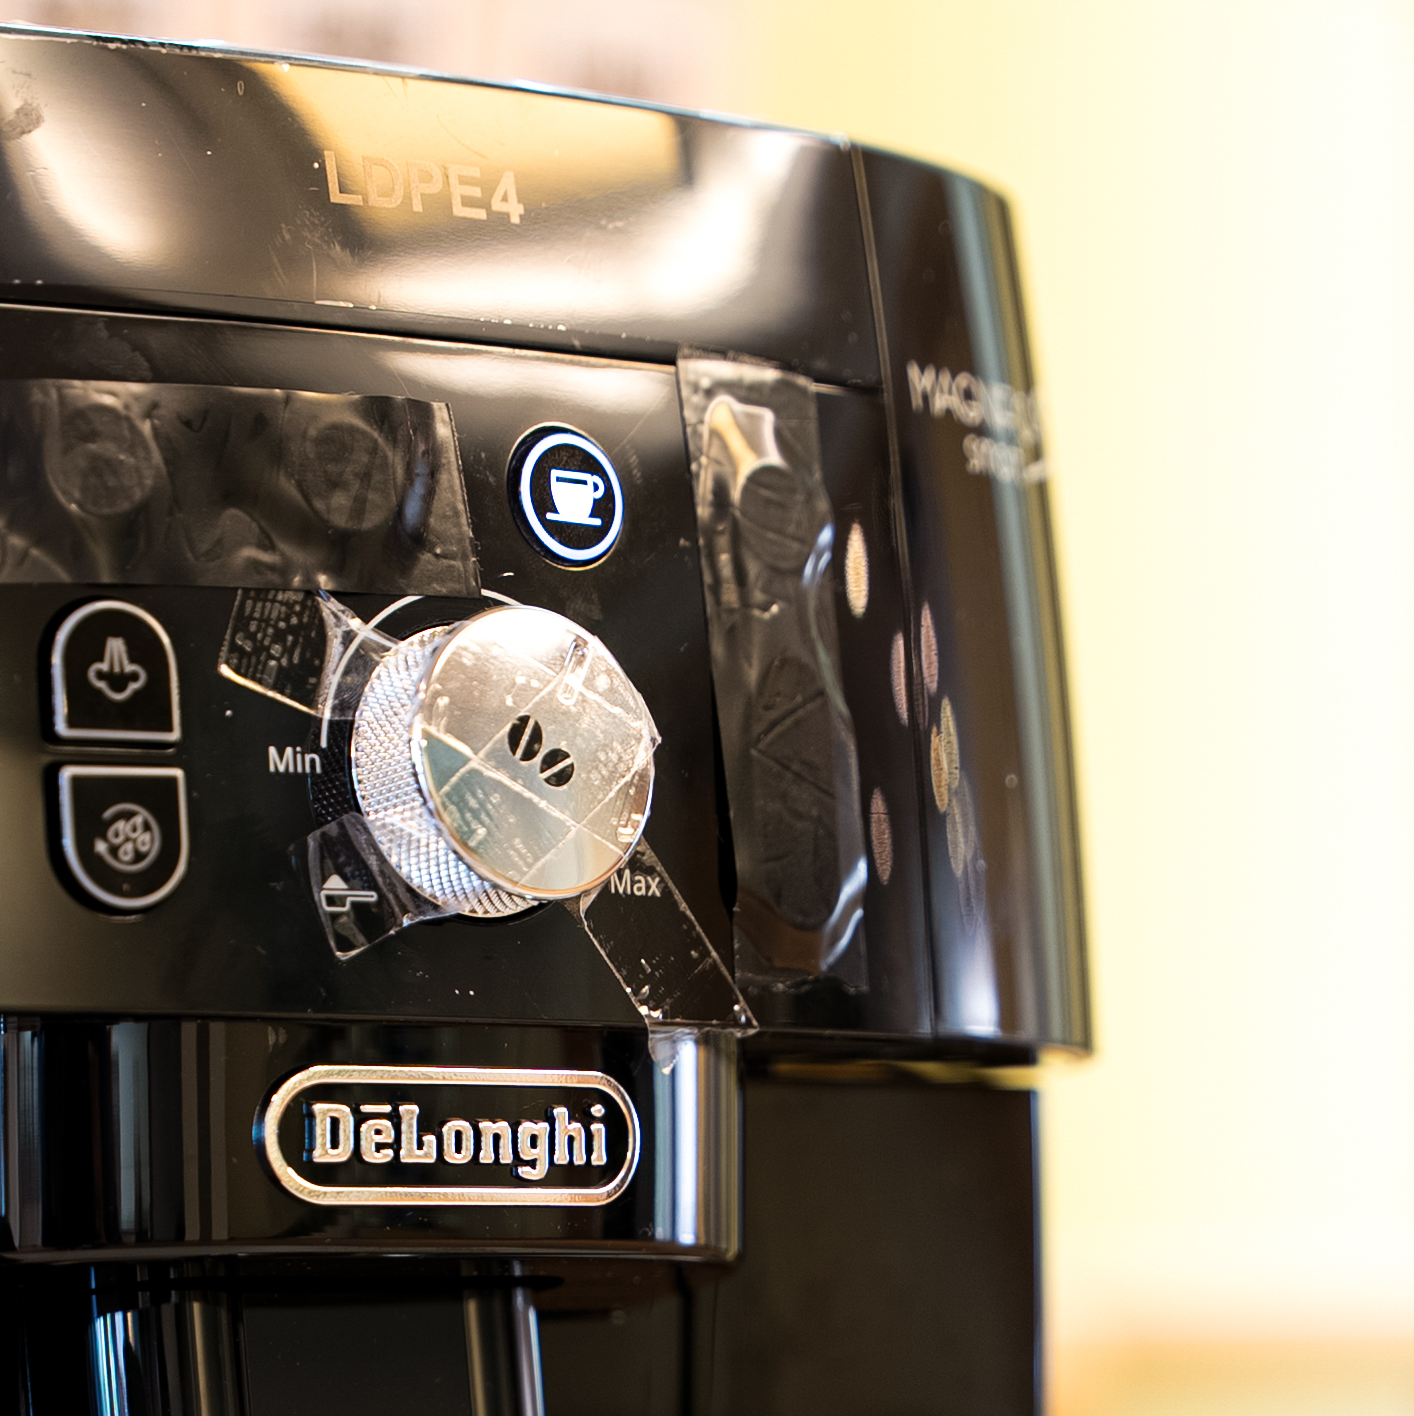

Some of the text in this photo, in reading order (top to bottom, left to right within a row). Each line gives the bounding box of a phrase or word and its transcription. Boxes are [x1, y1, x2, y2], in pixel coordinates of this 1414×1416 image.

[324, 150, 525, 225] LDPE4
[268, 745, 322, 774] Min
[610, 868, 661, 898] Max
